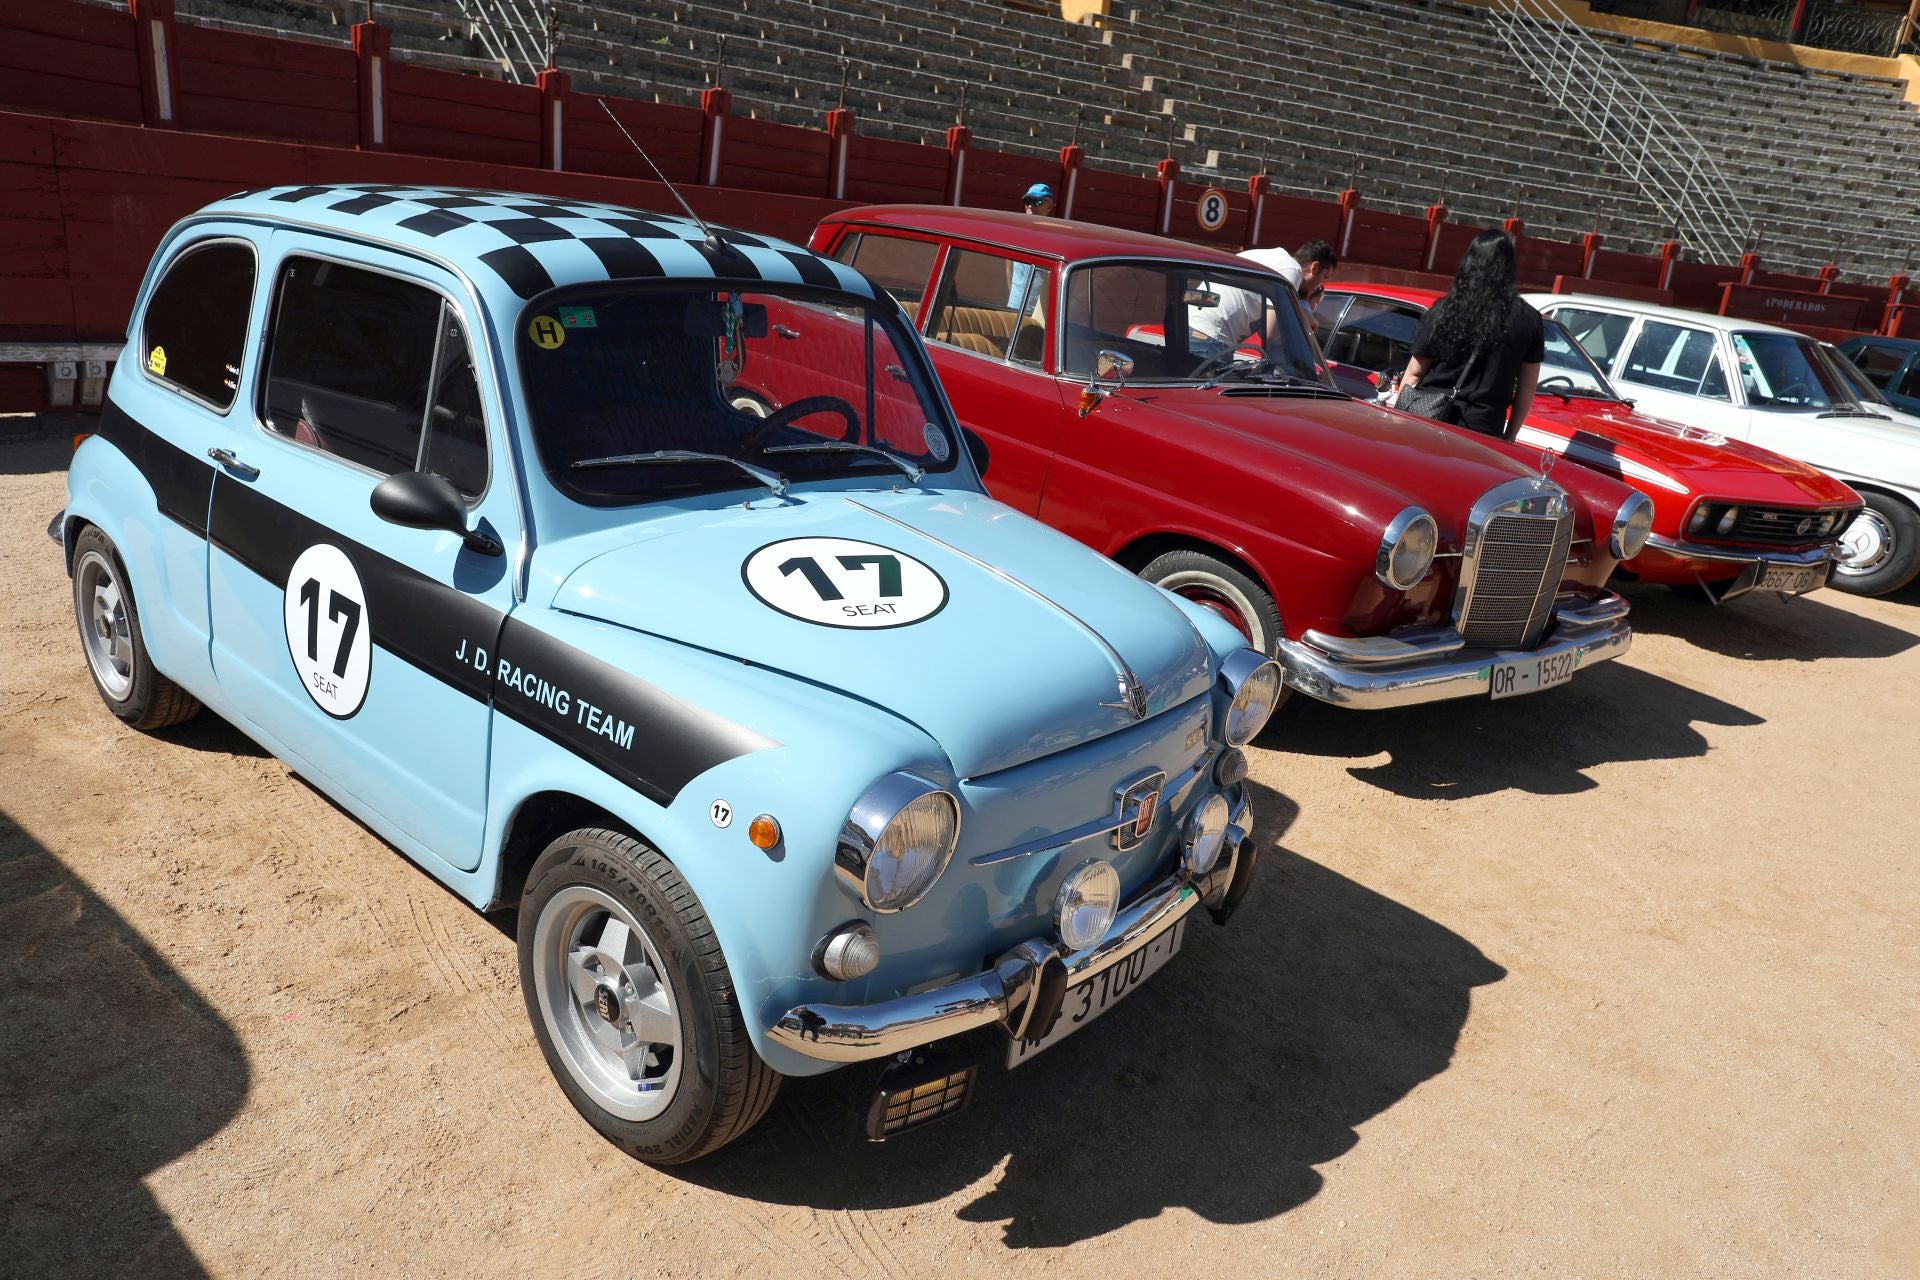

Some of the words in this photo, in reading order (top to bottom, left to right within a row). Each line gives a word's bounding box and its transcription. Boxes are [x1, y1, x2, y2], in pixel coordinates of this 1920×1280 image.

[1206, 197, 1220, 223] 8
[1765, 297, 1827, 312] APODERADOS
[535, 321, 559, 344] H
[777, 554, 903, 602] 17
[841, 602, 898, 617] SEAT
[299, 576, 362, 680] 17
[312, 671, 338, 701] SEAT
[1494, 665, 1516, 694] OR
[1536, 652, 1573, 687] 15522
[455, 638, 469, 664] J.
[473, 646, 491, 676] D.
[497, 658, 571, 716] RACING
[576, 698, 636, 751] TEAM
[713, 804, 730, 822] 17
